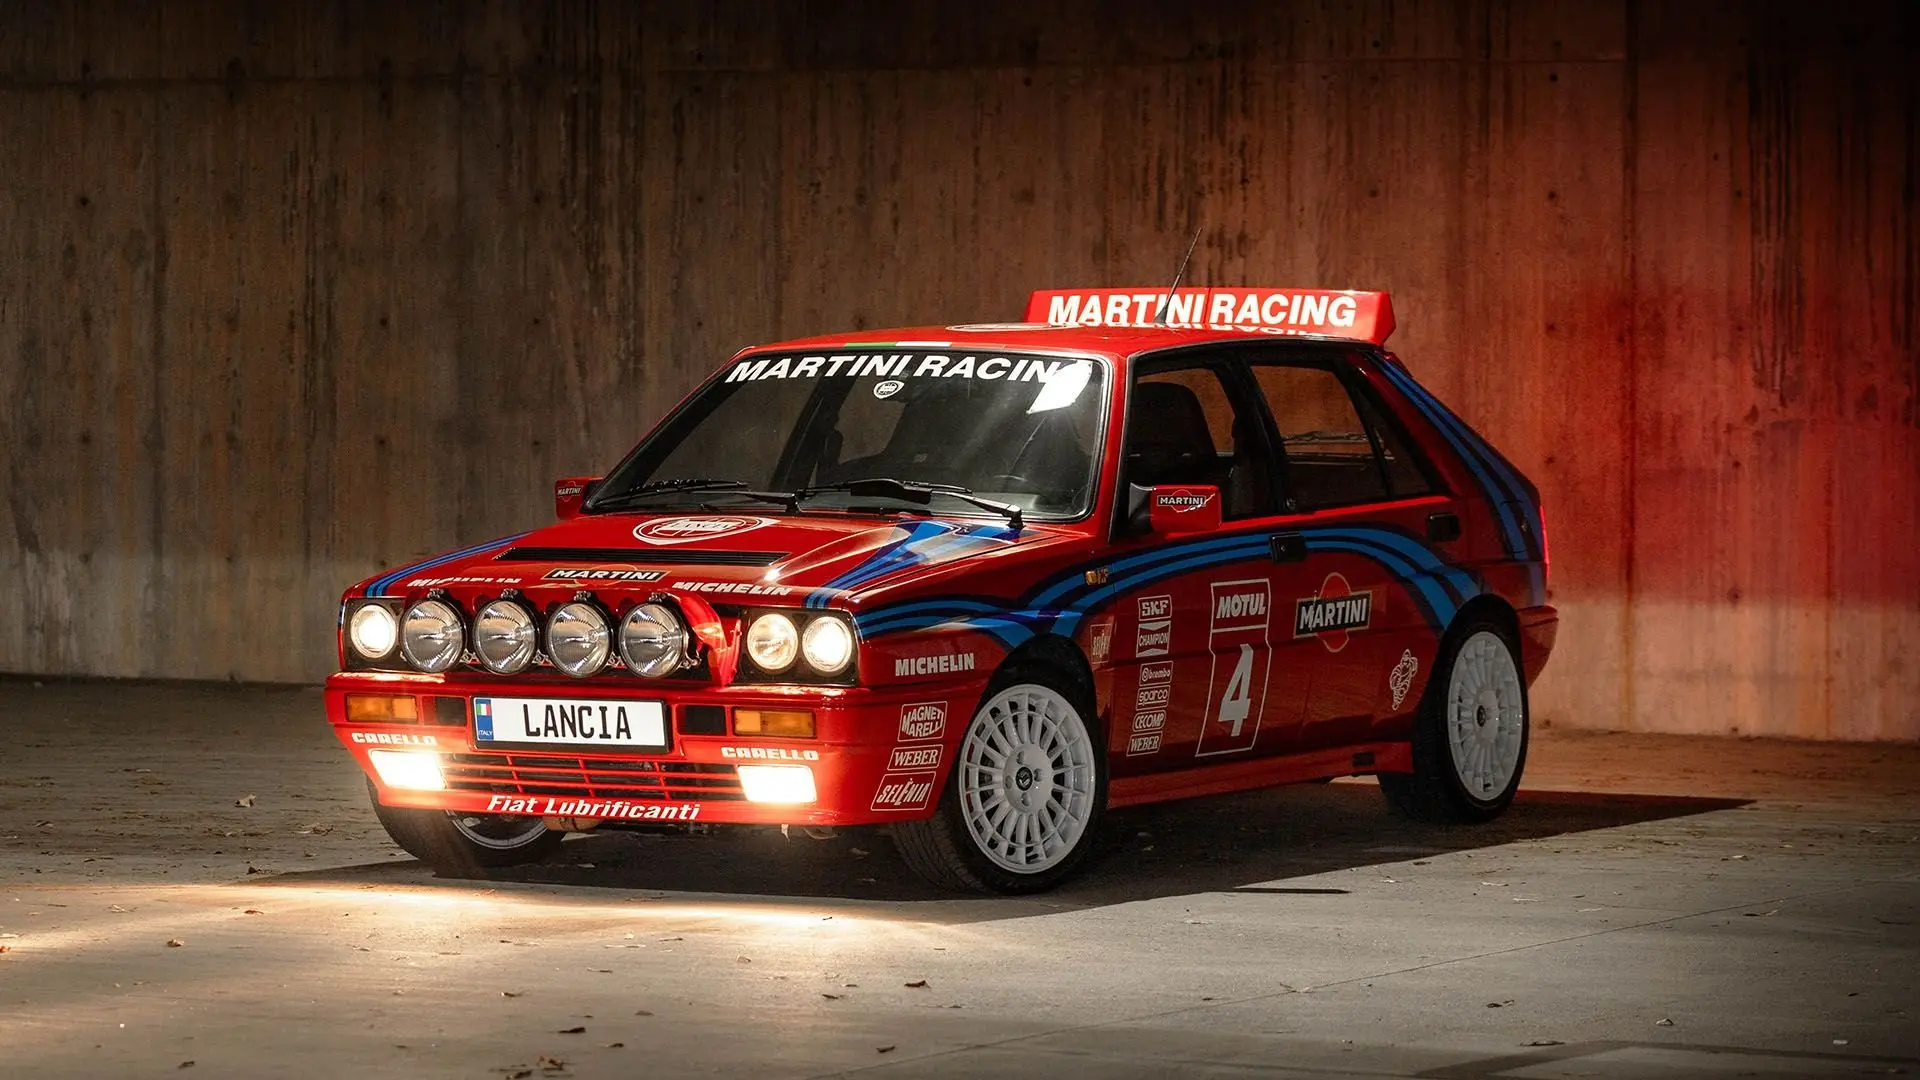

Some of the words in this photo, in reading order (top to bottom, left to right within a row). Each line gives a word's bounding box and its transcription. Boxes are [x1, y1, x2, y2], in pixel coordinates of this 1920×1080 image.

[1048, 294, 1201, 326] MARTINI
[1209, 294, 1357, 326] RACING
[725, 355, 912, 383] MARTINI
[913, 356, 1085, 385] RACIN
[557, 487, 582, 496] MARTINI
[1160, 497, 1204, 505] MARTINI
[552, 570, 660, 580] MARTINI
[672, 581, 793, 596] MICHELIN
[1141, 600, 1169, 616] SKF
[1216, 593, 1266, 619] MOTUL
[1300, 598, 1368, 629] MARTINI
[1139, 632, 1168, 647] CHAMPION
[895, 653, 975, 676] MICHELIN
[1148, 667, 1171, 680] brembo
[1139, 689, 1168, 704] sparco
[1218, 643, 1254, 737] 4
[523, 704, 632, 740] LANCIA
[1135, 713, 1165, 729] CECOMP
[351, 732, 438, 746] CARELLO
[1130, 735, 1160, 752] WEBER
[721, 747, 819, 760] CARELLO
[894, 749, 939, 766] WEBER
[487, 795, 538, 813] Fiat
[543, 798, 700, 821] Lubrificanti
